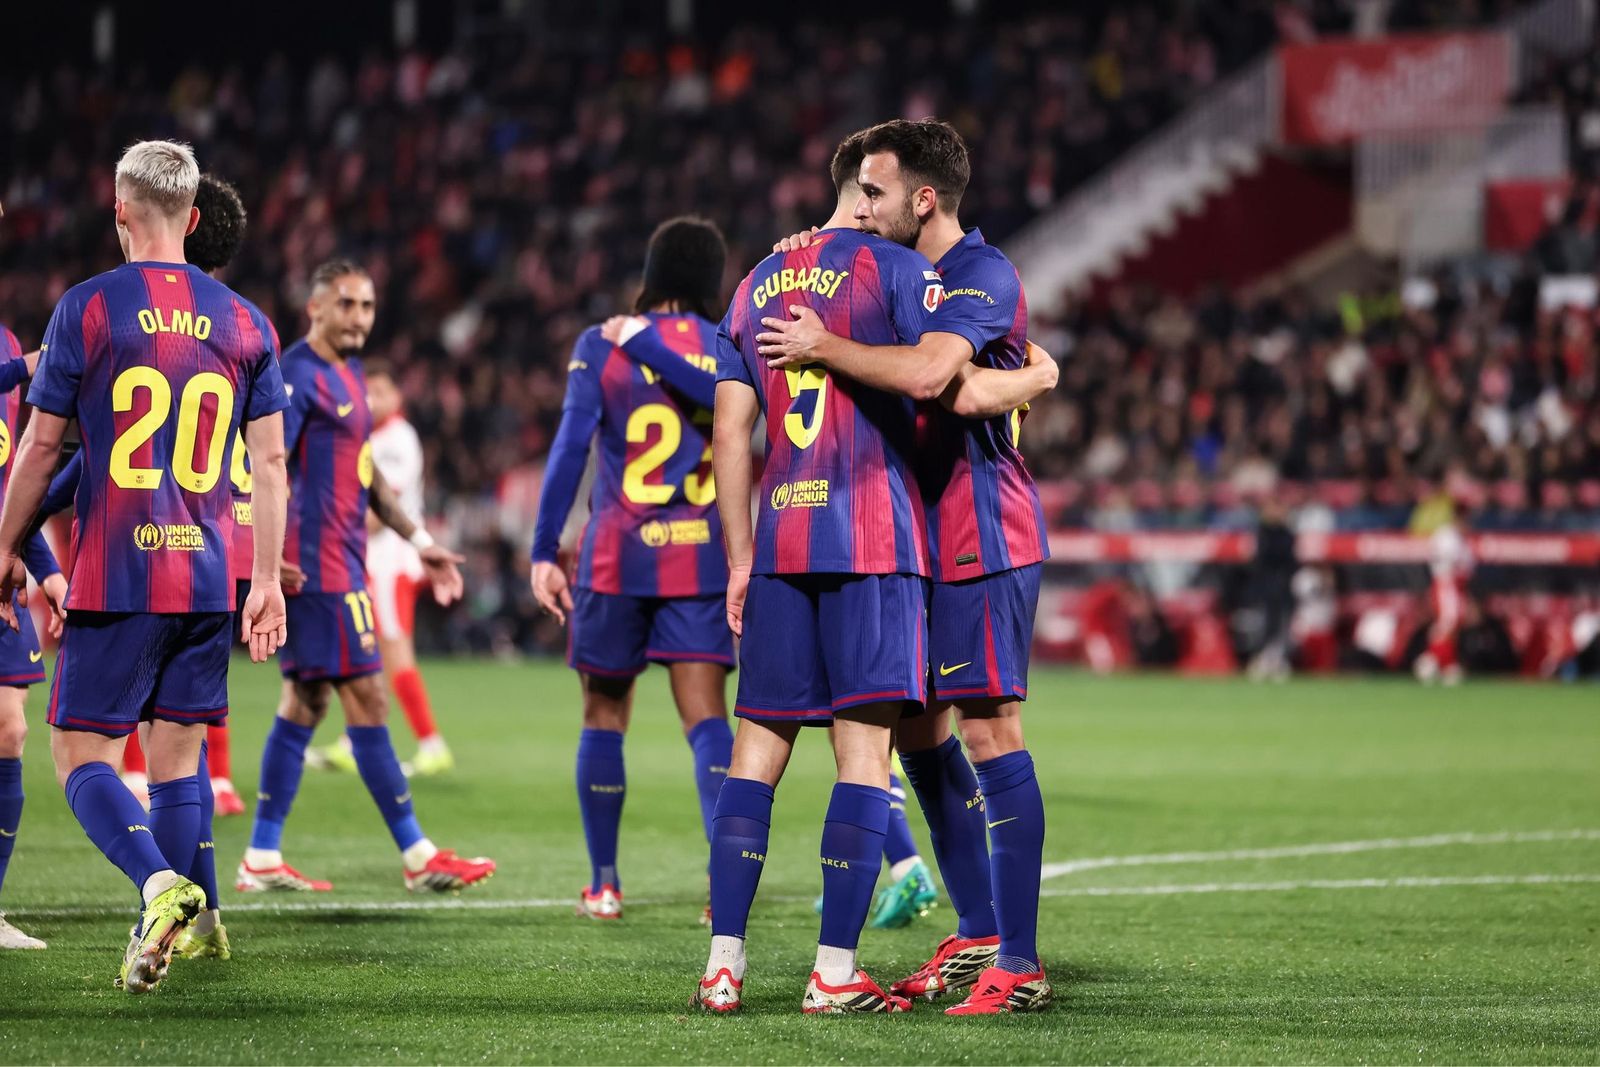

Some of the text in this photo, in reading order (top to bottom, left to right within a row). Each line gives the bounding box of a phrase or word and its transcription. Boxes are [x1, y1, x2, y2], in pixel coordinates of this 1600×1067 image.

[753, 267, 849, 309] CUBARSÍ
[137, 309, 212, 341] OLMO
[784, 363, 827, 450] 5
[109, 365, 234, 494] 20
[793, 480, 828, 492] UNHCR
[791, 491, 828, 503] ACNUR
[165, 525, 202, 536] UNHCR
[166, 535, 205, 547] ACNUR
[741, 850, 767, 863] BAR
[820, 857, 849, 870] ARÇA
